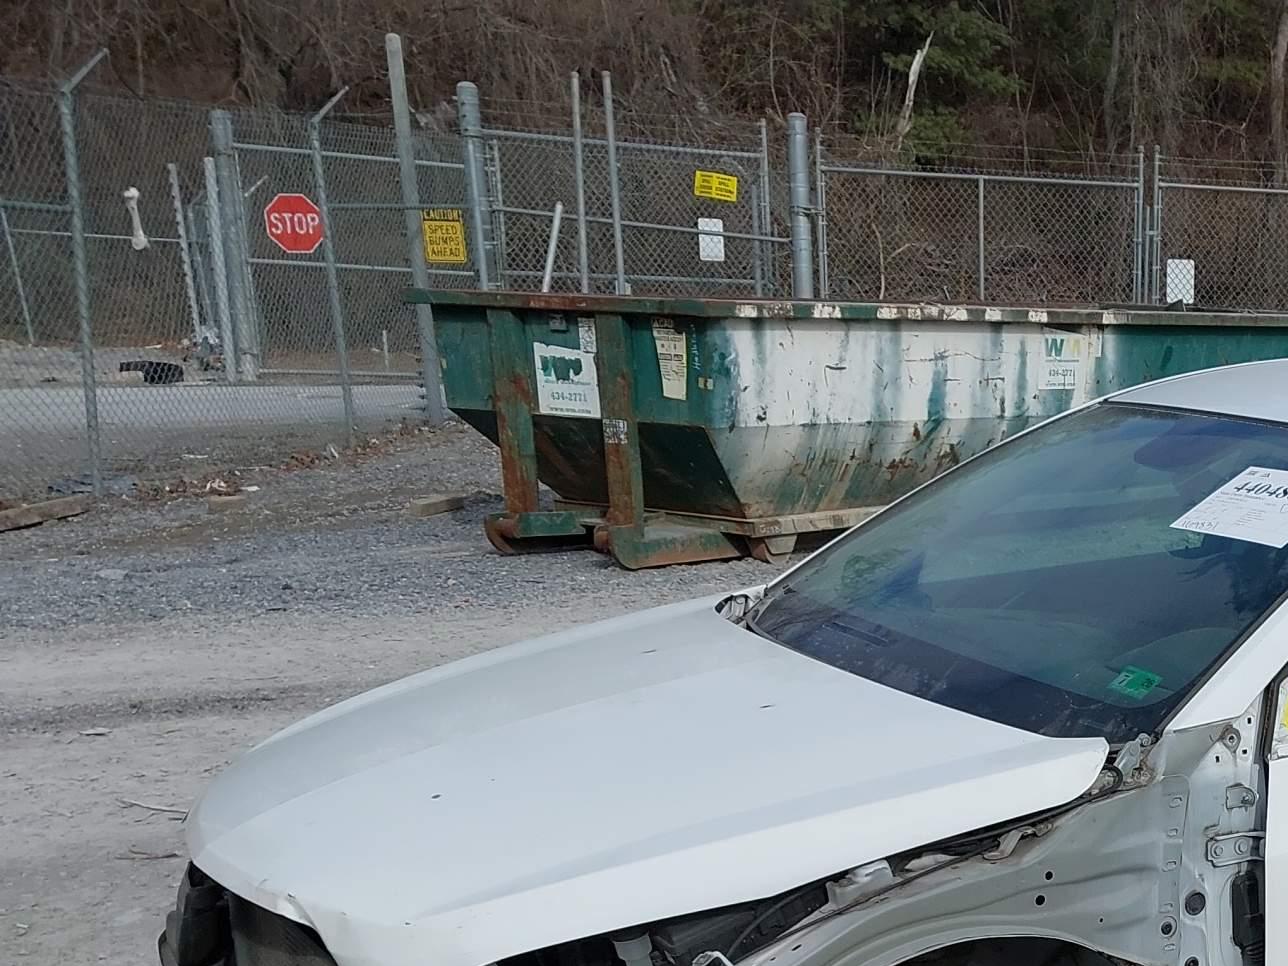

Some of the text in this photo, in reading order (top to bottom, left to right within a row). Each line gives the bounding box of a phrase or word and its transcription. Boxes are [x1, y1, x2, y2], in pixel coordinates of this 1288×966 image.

[270, 212, 319, 234] STOP
[428, 224, 458, 235] SPEED
[428, 235, 460, 246] BUMPS
[430, 246, 461, 257] AHEAD
